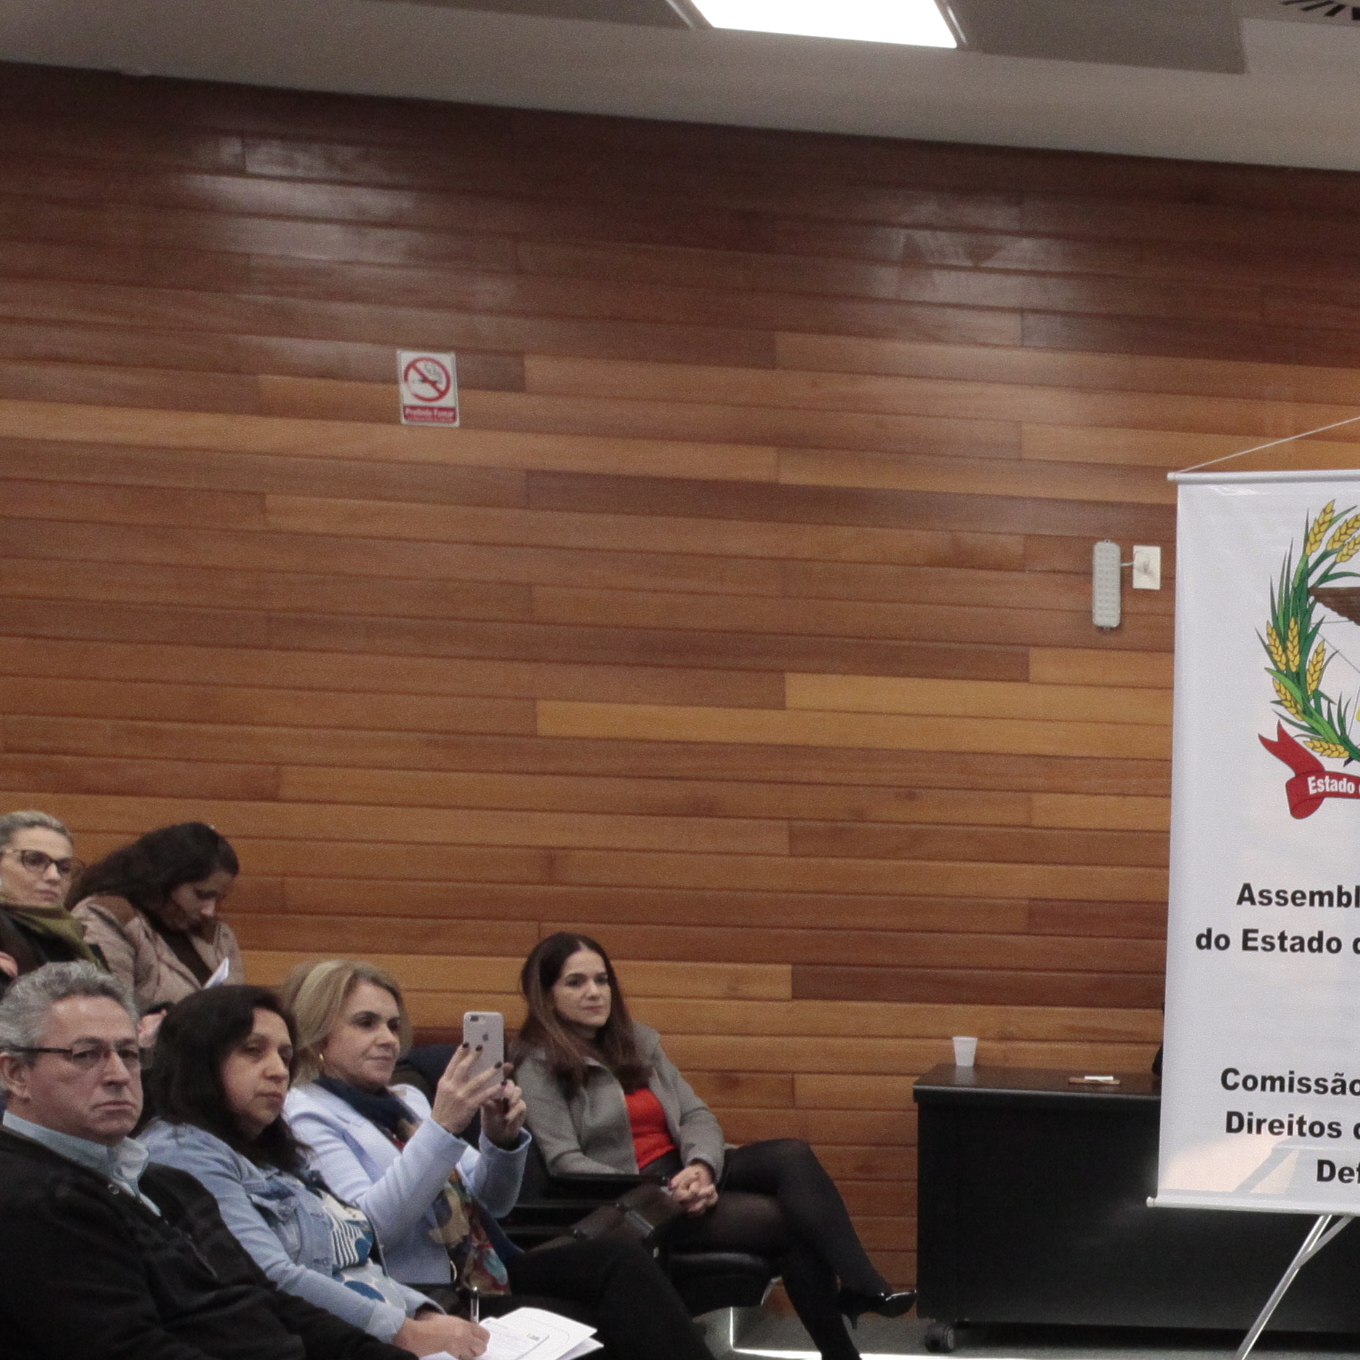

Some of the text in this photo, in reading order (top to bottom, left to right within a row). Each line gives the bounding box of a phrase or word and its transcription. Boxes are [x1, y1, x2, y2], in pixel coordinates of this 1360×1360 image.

[1307, 775, 1356, 795] Estado
[1195, 927, 1231, 951] do
[1241, 928, 1343, 955] Estado
[1225, 1111, 1343, 1139] Direitos
